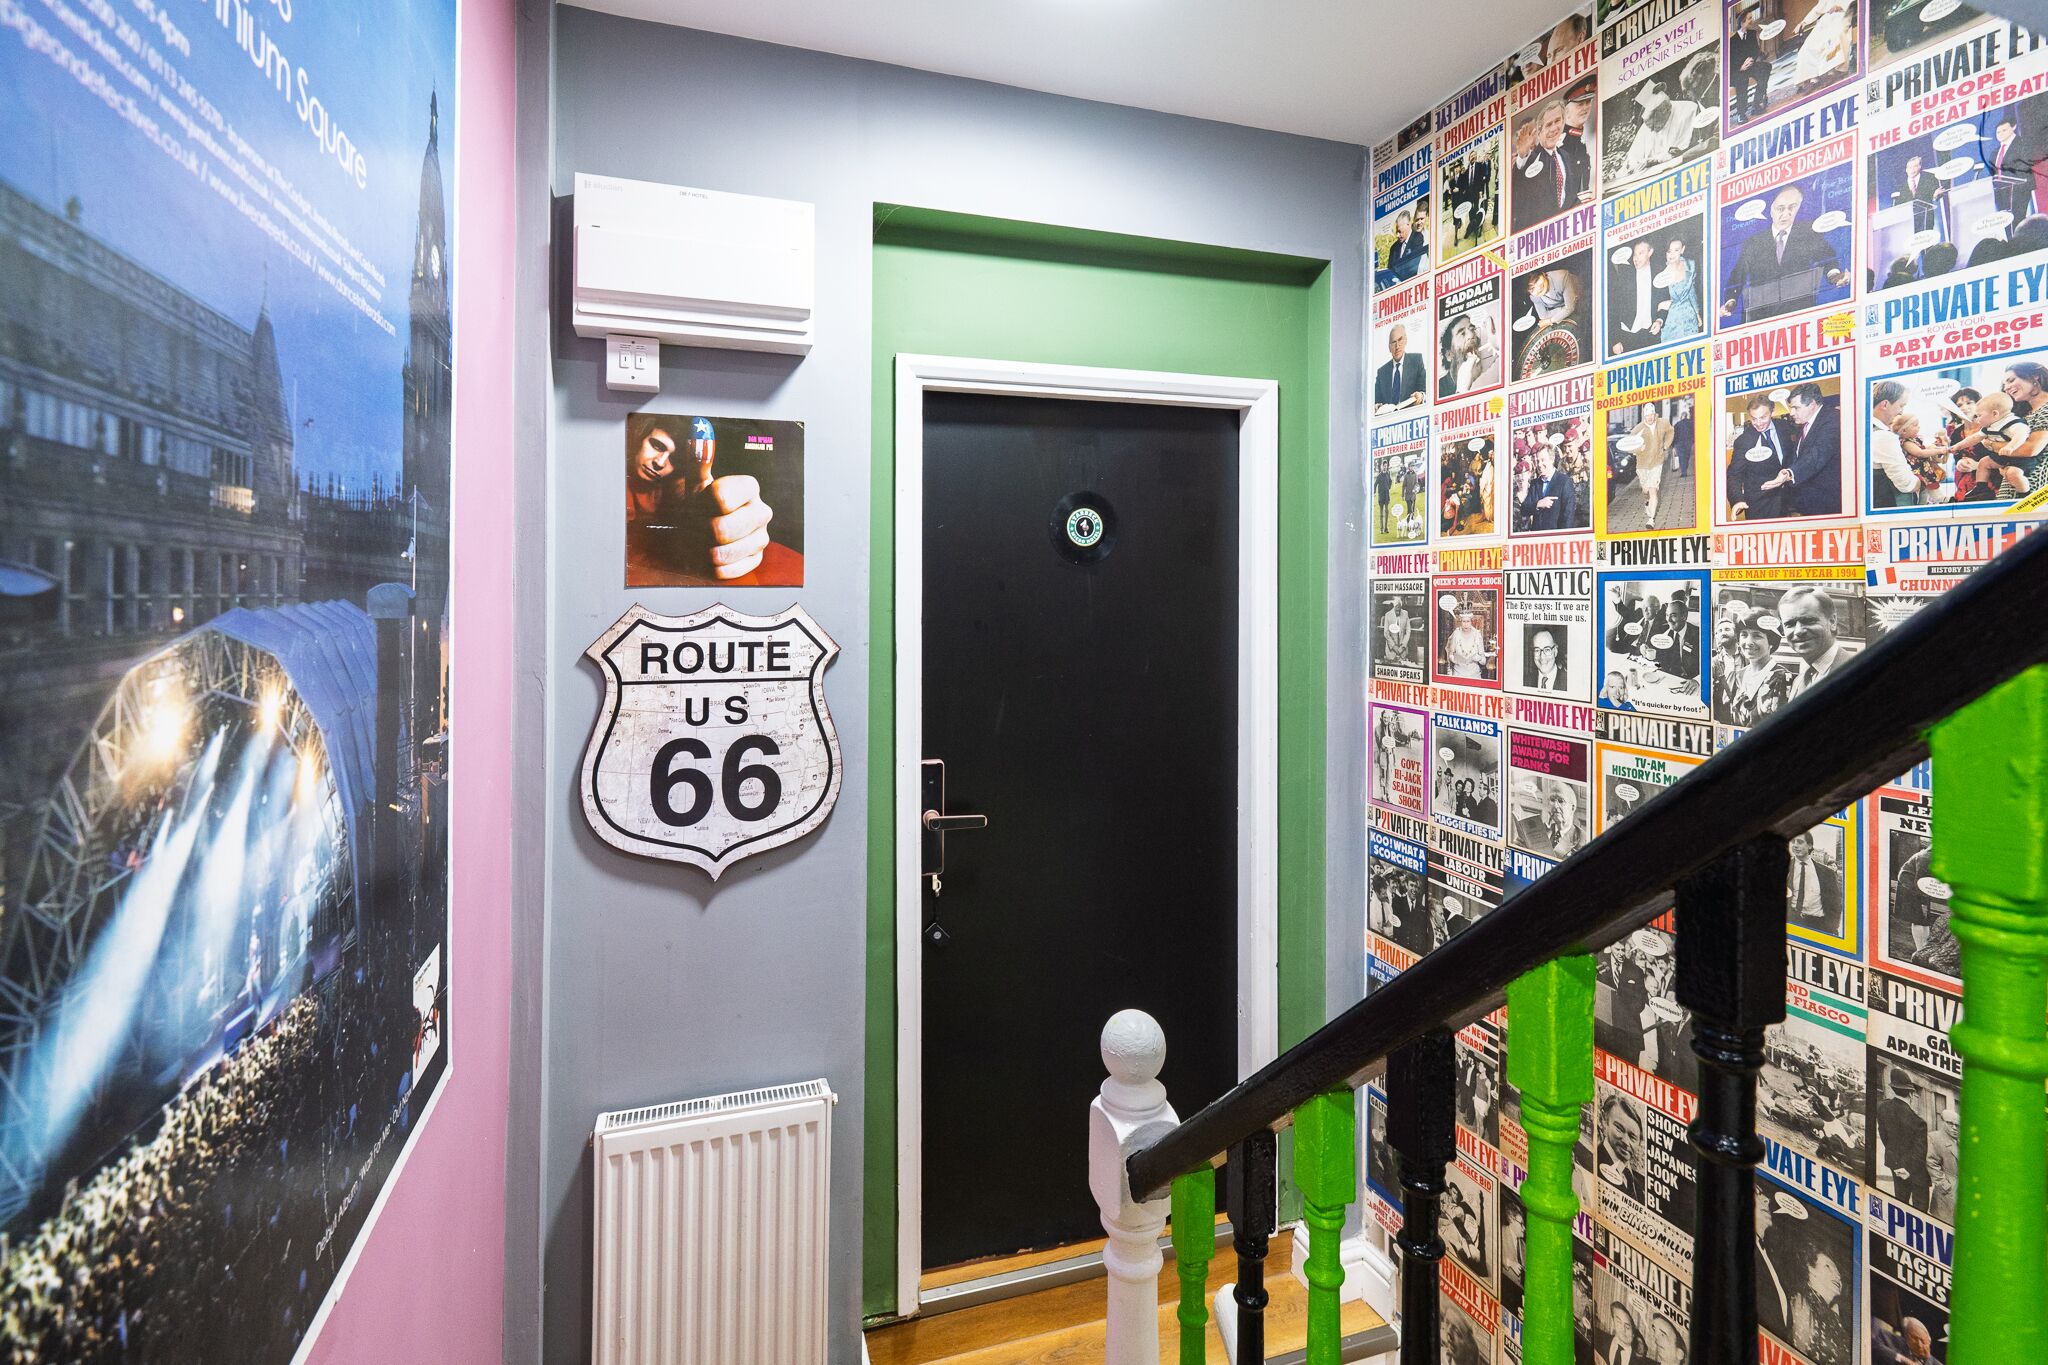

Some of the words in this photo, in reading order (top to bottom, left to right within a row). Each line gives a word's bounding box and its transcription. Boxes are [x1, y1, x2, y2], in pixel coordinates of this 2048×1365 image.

[1618, 47, 1671, 85] SOUVENIR
[1672, 28, 1704, 54] ISSUE
[1622, 39, 1662, 68] POPE'S
[1663, 18, 1697, 44] VISIT
[1519, 56, 1571, 108] PRIVATE
[1574, 39, 1599, 75] EYE
[1886, 30, 2002, 108] PRIVATE
[1911, 67, 2006, 116] EUROPE
[296, 67, 367, 189] Square
[1444, 108, 1486, 152] PRIVATE
[1488, 95, 1507, 125] EYE
[1730, 112, 1815, 175] PRIVATE
[1819, 94, 1859, 137] EYE
[1869, 128, 1901, 152] THE
[1908, 100, 1970, 137] GREAT
[1416, 142, 1432, 169] EYE
[1438, 142, 1473, 168] BLUNKETT
[1474, 136, 1482, 147] IN
[1484, 123, 1504, 140] LOVE
[1727, 160, 1793, 199] HOWARD'S
[1797, 141, 1846, 169] DREAM
[1385, 187, 1419, 214] INNOCENCE
[1614, 179, 1678, 225] PRIVATE
[1679, 159, 1710, 197] EYE
[1517, 215, 1569, 260] PRIVATE
[1573, 204, 1597, 235] EYE
[1511, 254, 1545, 277] LABOUR'S
[1547, 248, 1560, 261] BIG
[1562, 237, 1594, 256] GAMBLE
[1441, 260, 1483, 294] PRIVATE
[1379, 290, 1413, 319] PRIVATE
[1414, 280, 1429, 303] EYE
[1445, 280, 1493, 308] SADDAM
[1466, 296, 1488, 310] SHOCK
[1884, 274, 2000, 334] PRIVATE
[1725, 320, 1811, 370] PRIVATE
[1879, 334, 1935, 358] BABY
[1944, 313, 2043, 345] GEORGE
[1895, 333, 2022, 369] TRIUMPHS!
[1607, 356, 1673, 396] PRIVATE
[1676, 347, 1706, 379] EYE
[1727, 375, 1751, 392] THE
[1752, 370, 1779, 387] WAR
[1782, 362, 1816, 382] GOES
[1819, 357, 1838, 374] ON
[1518, 379, 1569, 415] PRIVATE
[1570, 374, 1593, 401] EYE
[1597, 393, 1624, 411] BORIS
[1626, 385, 1675, 404] SOUVENIR
[1678, 377, 1706, 393] ISSUE
[1441, 406, 1482, 432] PRIVATE
[1513, 415, 1532, 428] BLAIR
[1533, 410, 1563, 425] ANSWERS
[1564, 404, 1591, 419] CRITICS
[1387, 443, 1408, 455] TERRIER
[1409, 440, 1426, 451] ALERT
[1512, 543, 1566, 567] PRIVATE
[1569, 541, 1593, 565] EYE
[1610, 537, 1678, 566] PRIVATE
[1681, 535, 1711, 564] EYE
[1728, 531, 1817, 565] PRIVATE
[1821, 528, 1863, 562] EYE
[1377, 554, 1413, 575] PRIVATE
[1414, 553, 1429, 573] EYE
[1718, 569, 1744, 579] EYE'S
[1745, 569, 1766, 579] MAN
[1769, 569, 1781, 578] OF
[1783, 569, 1802, 578] THE
[1805, 568, 1832, 578] YEAR
[1836, 568, 1857, 578] 1994
[1931, 566, 1962, 574] HISTORY
[1376, 583, 1394, 591] BEIRUT
[1395, 582, 1423, 591] MASSACRE
[1458, 577, 1480, 585] SPEECH
[1505, 570, 1591, 596] LUNATIC
[1506, 602, 1519, 611] The
[1521, 602, 1533, 612] Eye
[1534, 603, 1553, 613] says:
[1555, 602, 1562, 611] If
[1532, 612, 1542, 621] let
[1543, 612, 1558, 621] him
[640, 641, 791, 674] ROUTE
[1377, 667, 1398, 678] SHARON
[1400, 669, 1421, 680] SPEAKS
[1375, 680, 1413, 704] PRIVATE
[1413, 686, 1429, 707] EYE
[1440, 688, 1483, 716] PRIVATE
[1485, 695, 1503, 719] EYE
[1646, 702, 1673, 712] quicker
[1673, 703, 1682, 713] by
[1437, 715, 1494, 735] FALKLANDS
[1515, 698, 1570, 728] PRIVATE
[1572, 706, 1595, 733] EYE
[1511, 733, 1570, 753] WHITEWASH
[1608, 713, 1678, 751] PRIVATE
[1680, 724, 1713, 756] EYE
[1511, 745, 1548, 761] AWARD
[1549, 753, 1570, 765] FOR
[1511, 756, 1551, 774] FRANKS
[1635, 757, 1666, 773] TV-AM
[650, 734, 782, 827] 66
[1392, 780, 1422, 798] SEALINK
[1394, 766, 1422, 786] HI-JACK
[1612, 765, 1650, 782] HISTORY
[1652, 772, 1661, 783] IS
[1398, 794, 1422, 811] SHOCK
[1434, 813, 1466, 831] MAGGIE
[1467, 821, 1489, 838] FLIES
[1370, 831, 1393, 849] KOO!
[1393, 838, 1418, 857] WHAT
[1418, 848, 1426, 861] A
[1373, 845, 1423, 872] SCORCHER!
[1438, 829, 1483, 864] PRIVATE
[1484, 846, 1504, 871] EYE
[1444, 856, 1486, 883] LABOUR
[1446, 874, 1483, 898] UNITED
[1823, 954, 1863, 1002] EYE
[1794, 995, 1850, 1025] FIASCO
[1471, 1026, 1488, 1044] NEW
[1606, 1053, 1674, 1115] PRIVATE
[1648, 1110, 1688, 1144] SHOCK
[1648, 1126, 1673, 1152] NEW
[1458, 1161, 1478, 1182] PEACE
[1480, 1176, 1492, 1191] BID
[1648, 1160, 1678, 1190] LOOK
[1621, 1195, 1644, 1214] INSIDE
[1648, 1179, 1671, 1202] FOR
[1821, 1165, 1860, 1216] EYE
[315, 1213, 337, 1261] Debut
[338, 1180, 359, 1222] Album
[1602, 1196, 1619, 1213] WIN
[1619, 1207, 1658, 1240] BINGO
[1640, 1286, 1662, 1310] NEW
[1897, 1263, 1947, 1303] LIFTS
